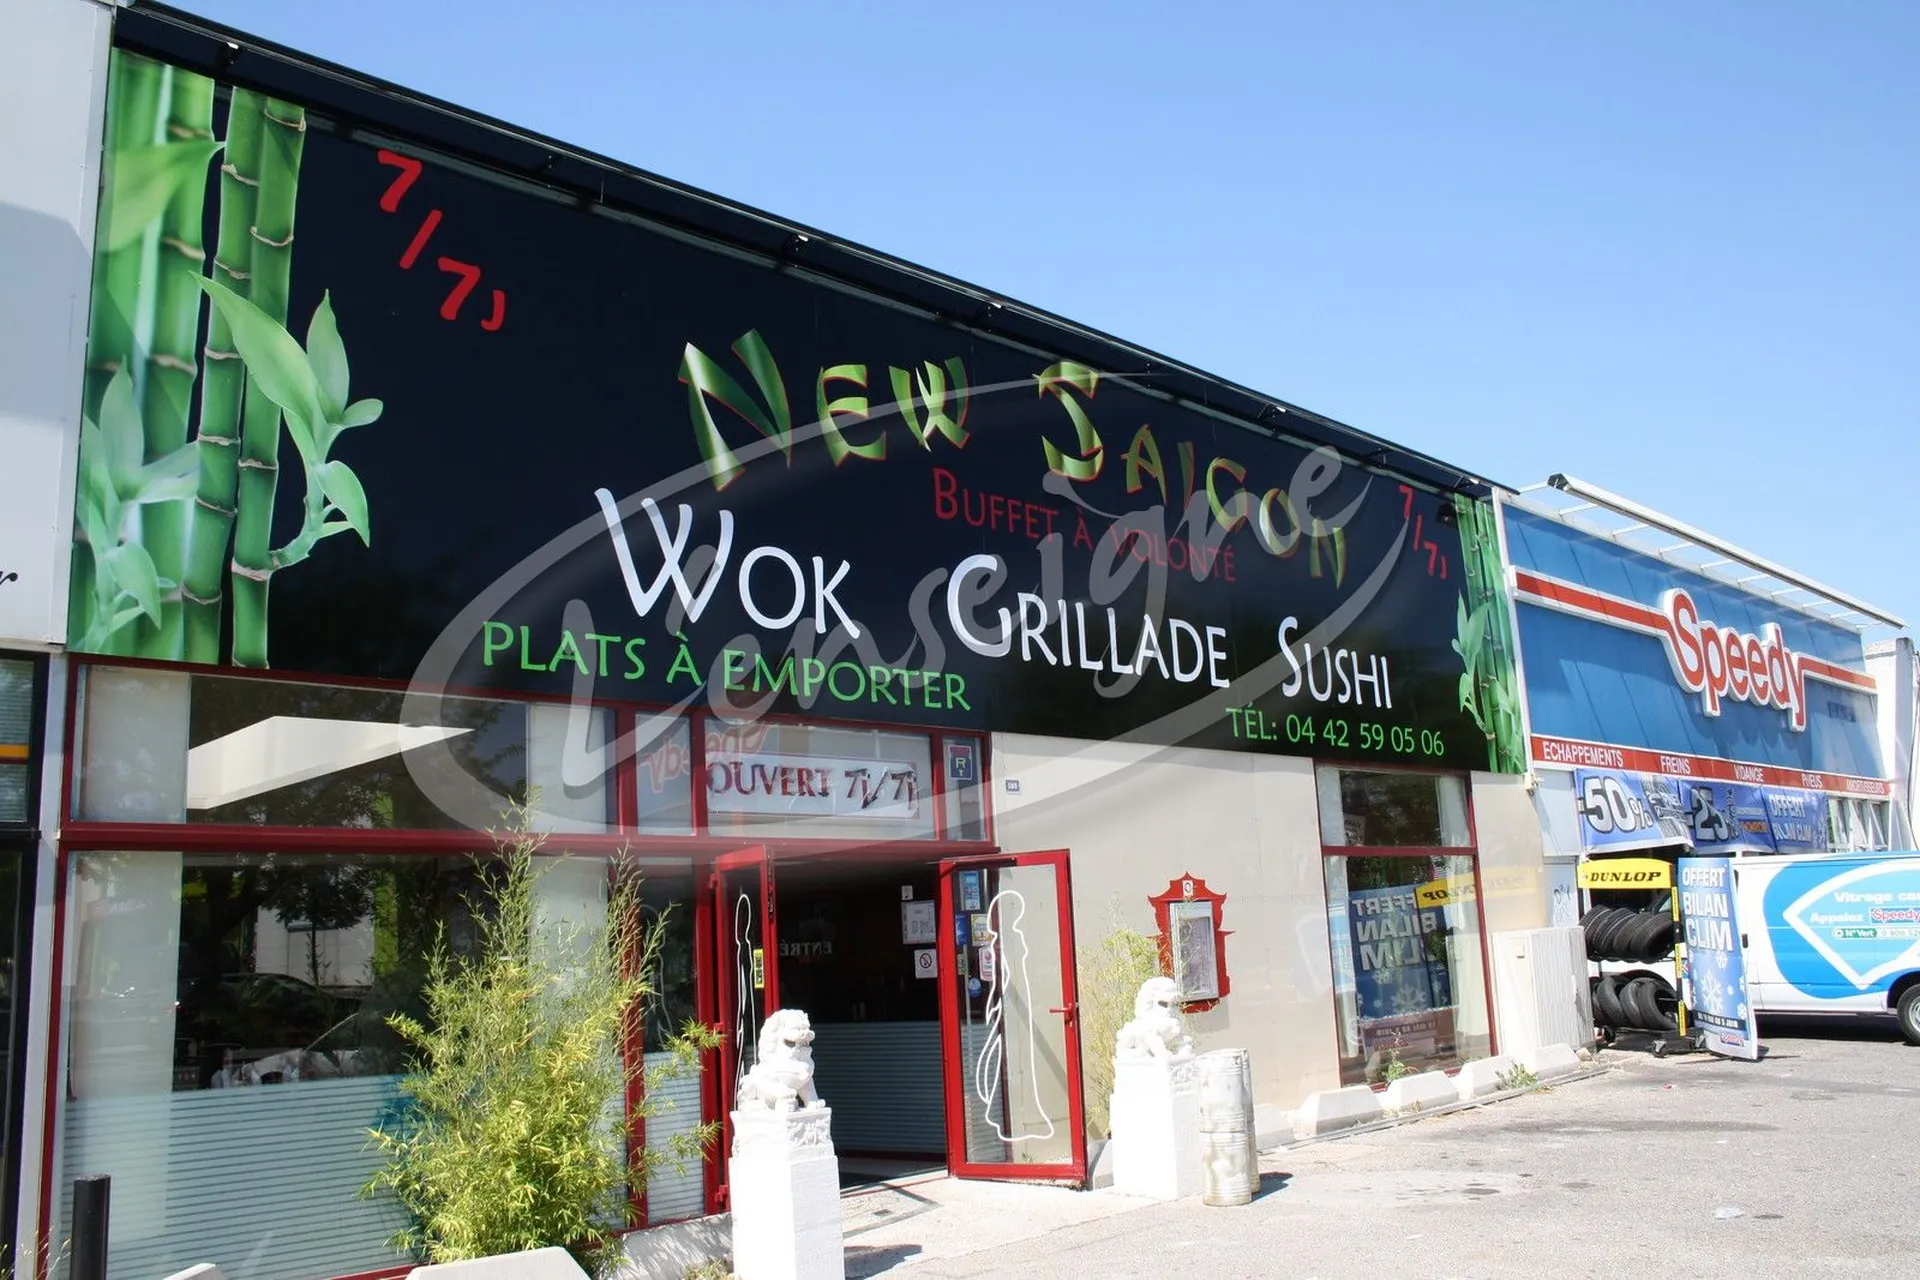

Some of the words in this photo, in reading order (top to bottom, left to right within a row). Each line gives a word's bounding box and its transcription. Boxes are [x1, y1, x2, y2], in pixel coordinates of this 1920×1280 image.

[678, 328, 970, 493] NEW
[1032, 360, 1347, 590] SAIGON
[932, 467, 1059, 542] BUFFET
[1073, 508, 1094, 551] À
[1109, 523, 1237, 582] VOLONTÉ
[594, 487, 862, 640] WOK
[947, 553, 1231, 689] GRILLADE
[1278, 615, 1394, 710] SUSHI
[482, 620, 647, 681] PLATS
[665, 630, 703, 687] À
[723, 648, 972, 712] EMPORTER
[1664, 588, 1807, 732] Speedy
[1225, 700, 1278, 742] TÉL:
[1286, 713, 1316, 746] 04
[1322, 718, 1350, 748] 42
[1359, 722, 1385, 751] 59
[1390, 725, 1416, 754] 05
[1421, 729, 1445, 757] 06
[1542, 740, 1624, 768] ECHAPPEMENTS
[1659, 755, 1692, 775] FREINS
[707, 759, 832, 798] OUVERT
[1733, 764, 1765, 783] VIDANGE
[1590, 871, 1662, 882] DUNLOP
[1682, 866, 1726, 889] OFFERT
[1682, 891, 1729, 918] BILAN
[1872, 906, 1920, 924] Speedy
[1685, 918, 1734, 952] CLIM
